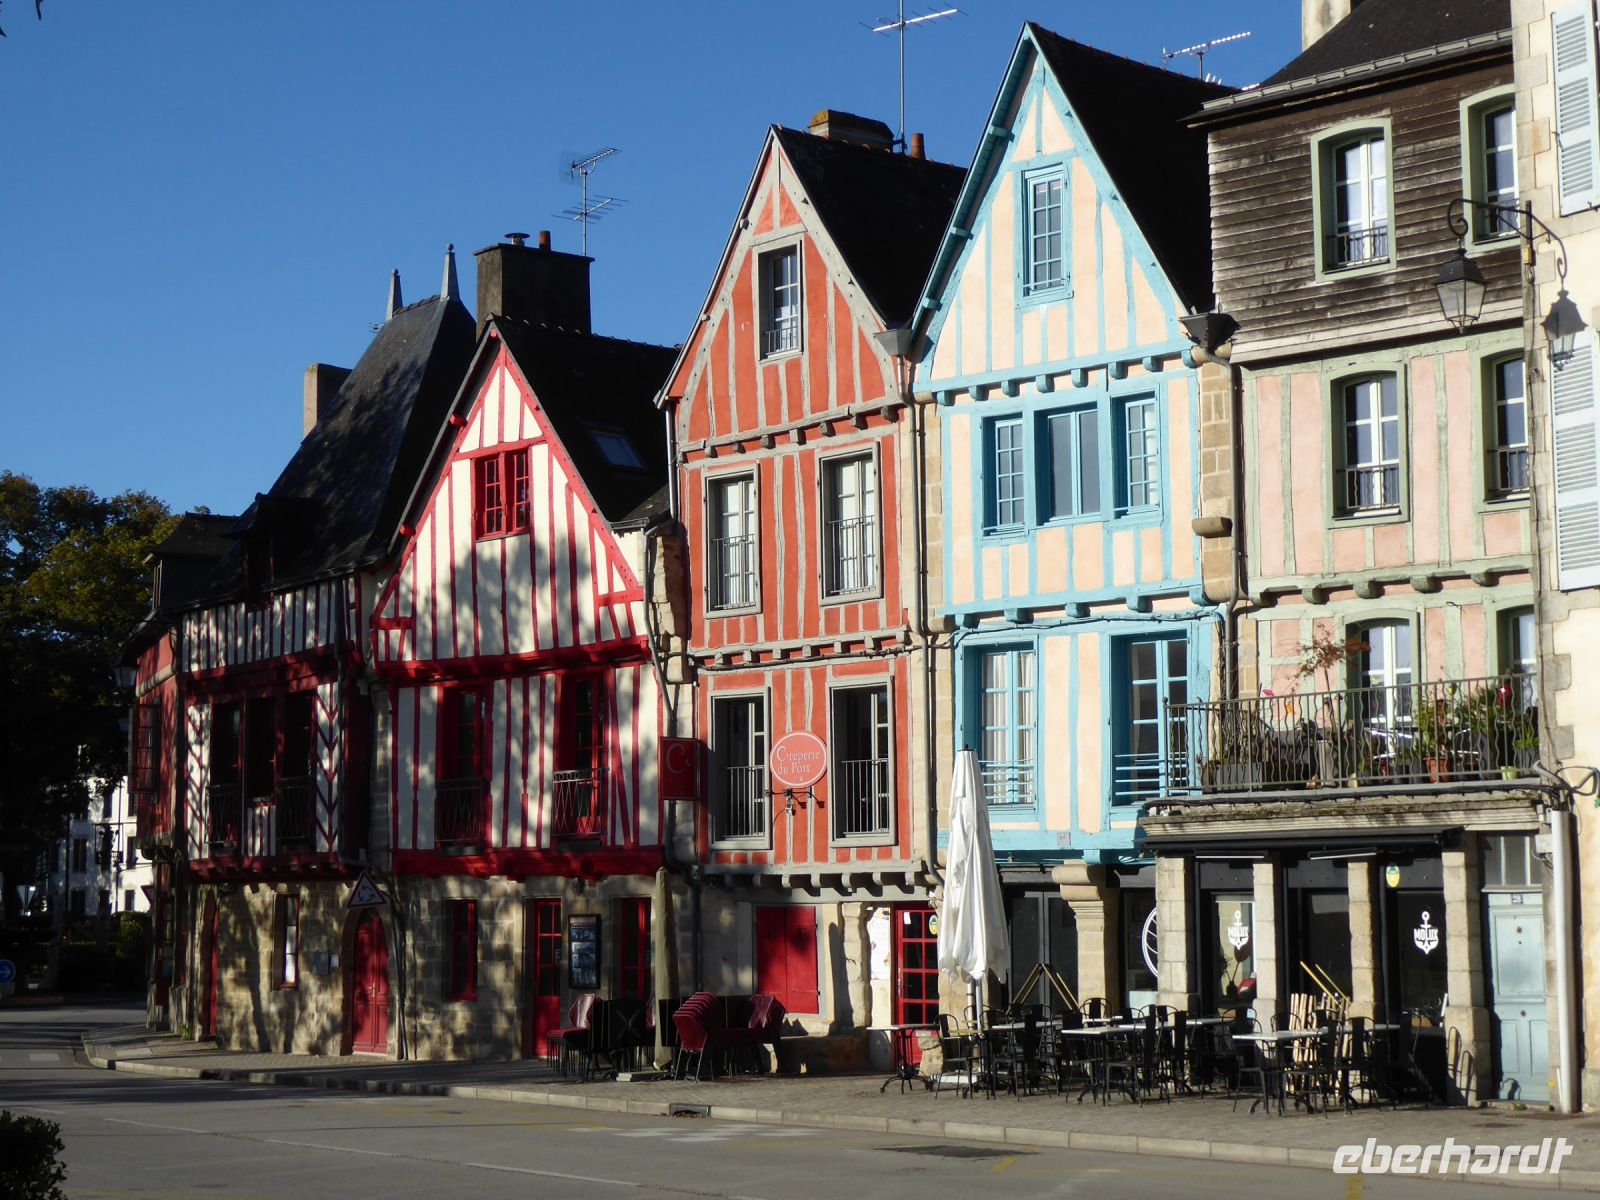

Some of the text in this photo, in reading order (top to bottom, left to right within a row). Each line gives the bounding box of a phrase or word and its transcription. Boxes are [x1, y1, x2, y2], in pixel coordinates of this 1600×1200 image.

[777, 762, 811, 774] du Port
[1227, 926, 1249, 938] MOLUX
[1414, 928, 1439, 941] MOLUX
